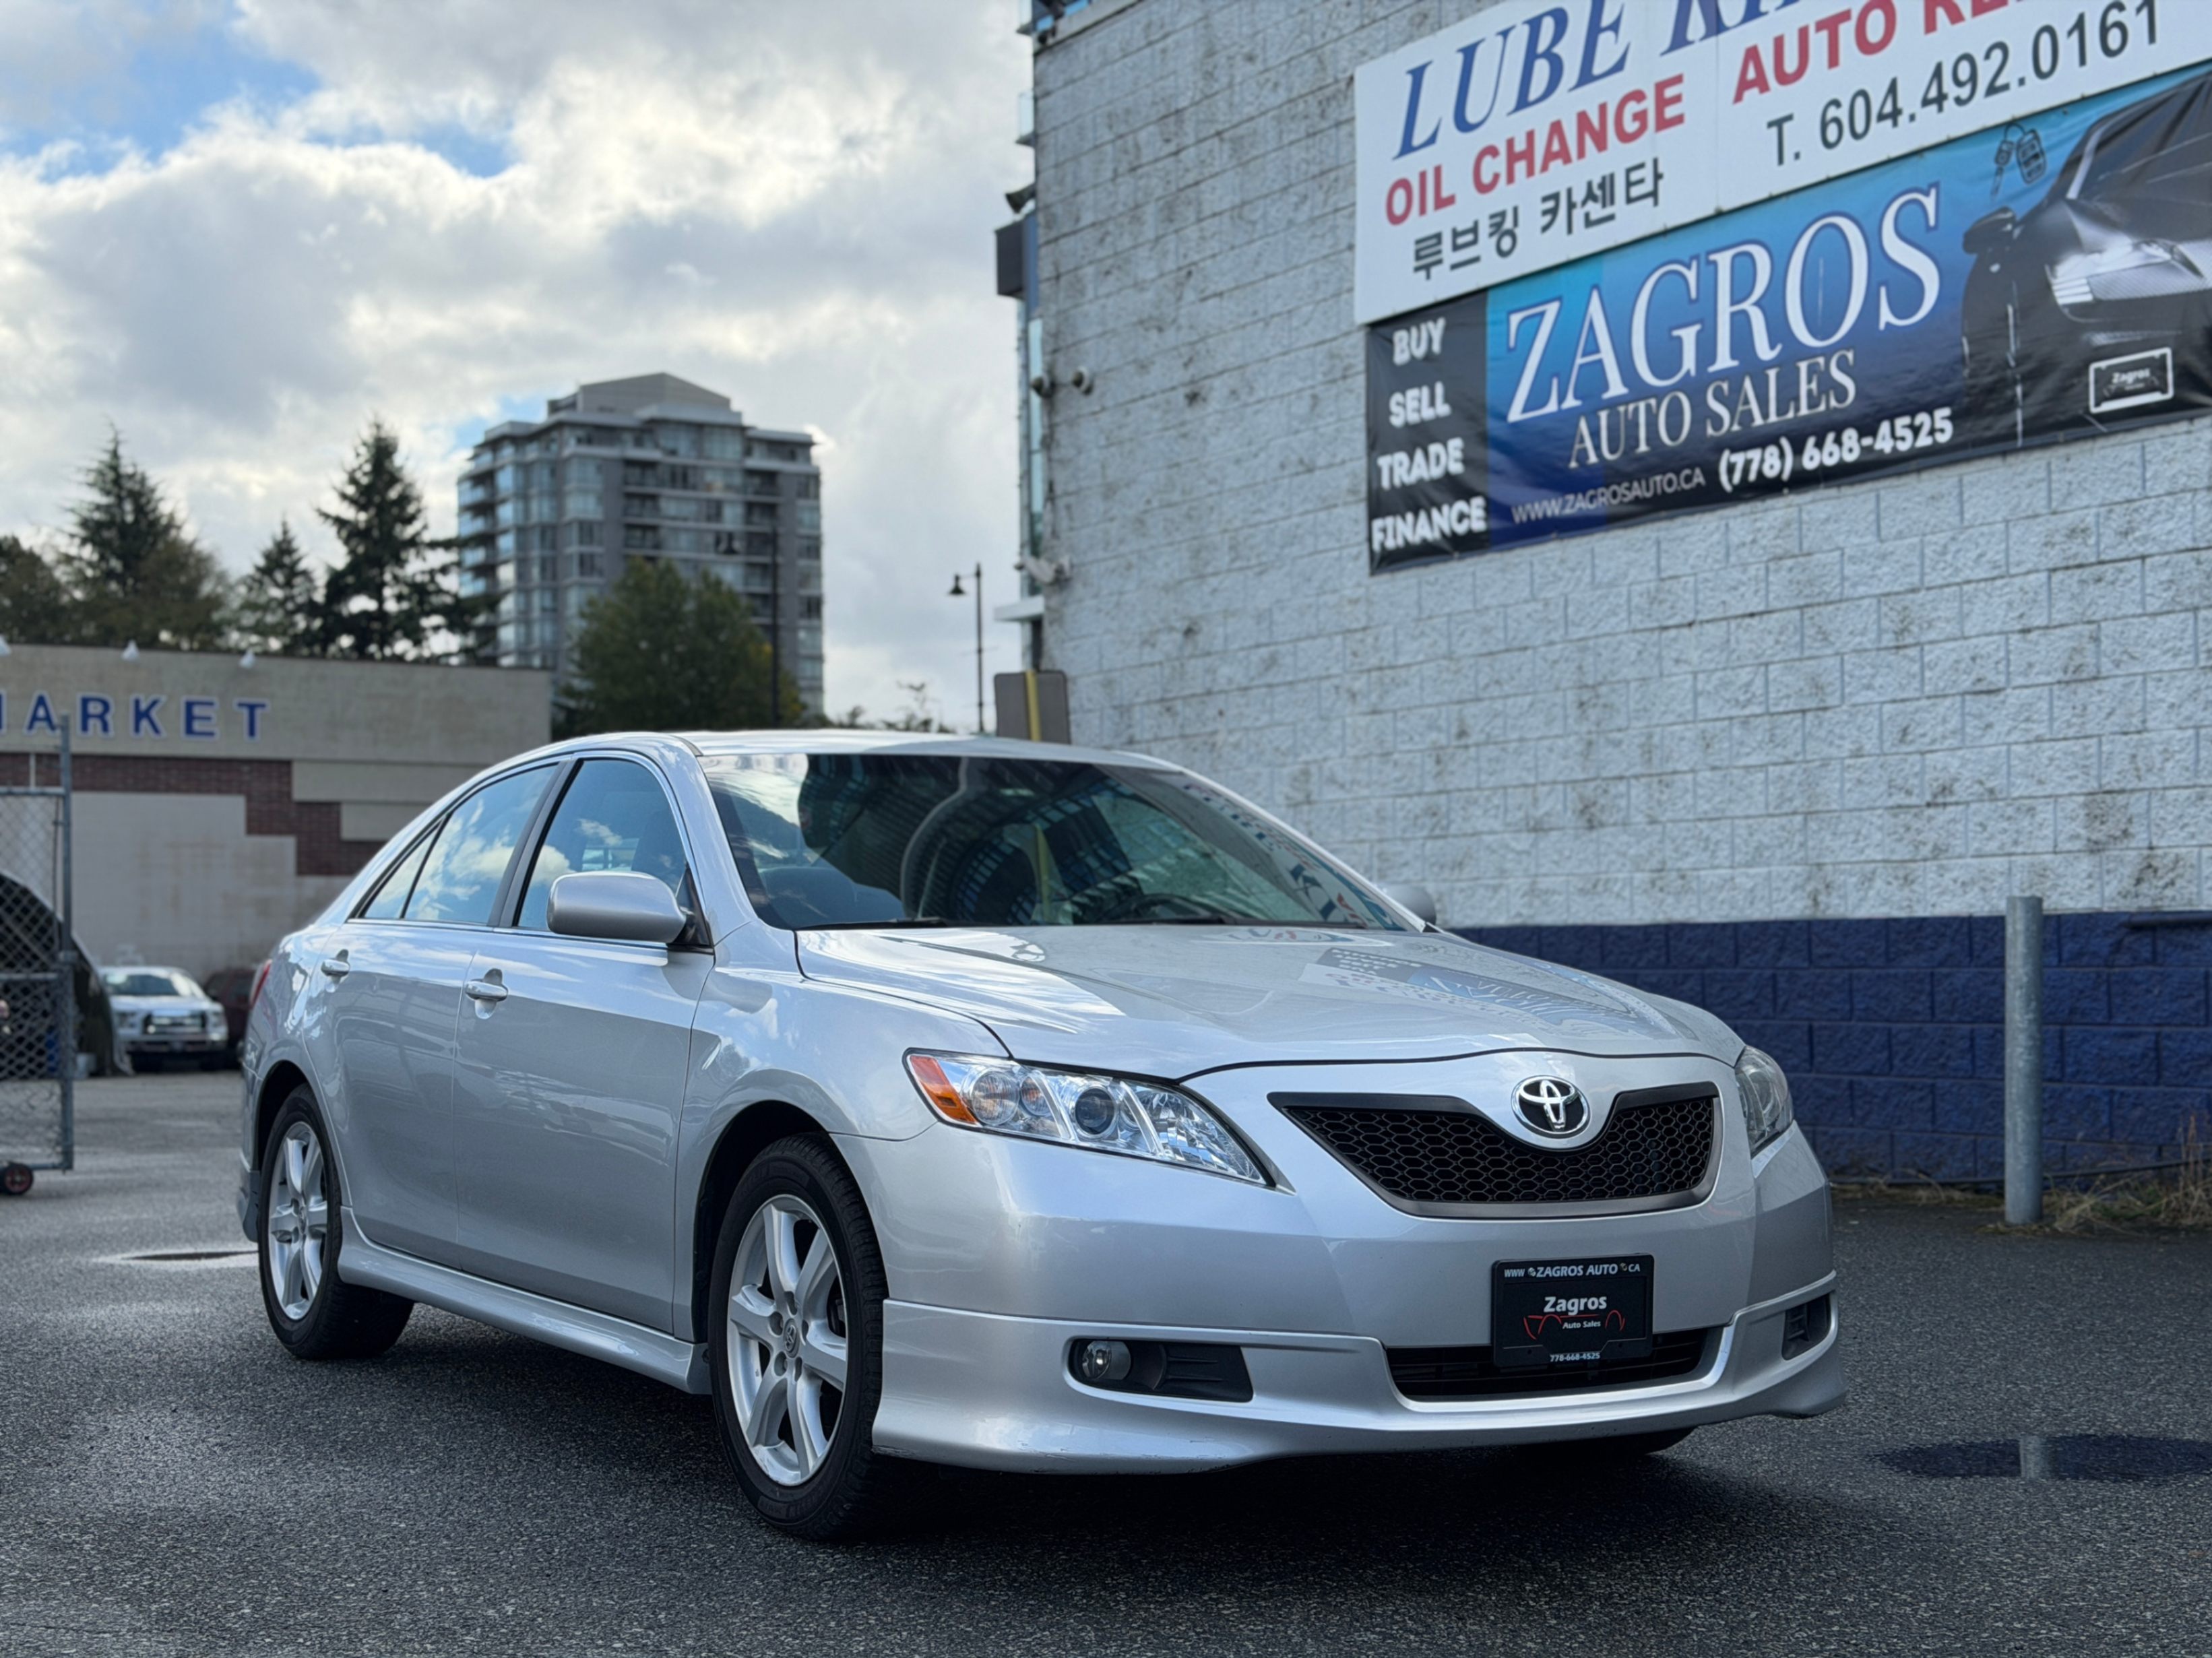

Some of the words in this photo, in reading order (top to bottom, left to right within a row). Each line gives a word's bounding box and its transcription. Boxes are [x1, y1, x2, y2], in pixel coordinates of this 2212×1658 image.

[1392, 0, 1631, 160] LUBE
[1767, 113, 1801, 166] T.
[1819, 0, 2157, 150] 604.492.0161
[1385, 164, 1456, 226] OIL
[1472, 73, 1685, 195] CHANGE
[1733, 0, 1897, 105] AUTO
[1413, 205, 1519, 281] 루브킹
[1540, 157, 1664, 236] 카센타
[1507, 181, 1940, 423] ZAGROS
[1393, 317, 1447, 366] BUY
[1389, 381, 1452, 428] SELL
[1569, 391, 1692, 469] AUTO
[1706, 349, 1857, 439] SALES
[1377, 437, 1465, 491] TRADE
[1511, 467, 1706, 524] WWW.ZAGROSAUTO.CA
[1719, 437, 1794, 493] (778)
[1801, 407, 1954, 471] 668-4525
[1370, 496, 1488, 553] FINANCE
[1536, 1265, 1583, 1278] ZAGROS
[1585, 1263, 1618, 1276] AUTO
[1543, 1296, 1607, 1315] Zagros
[1562, 1321, 1581, 1329] Auto
[1583, 1320, 1601, 1329] Sales
[1550, 1352, 1601, 1362] 778-668-4525
